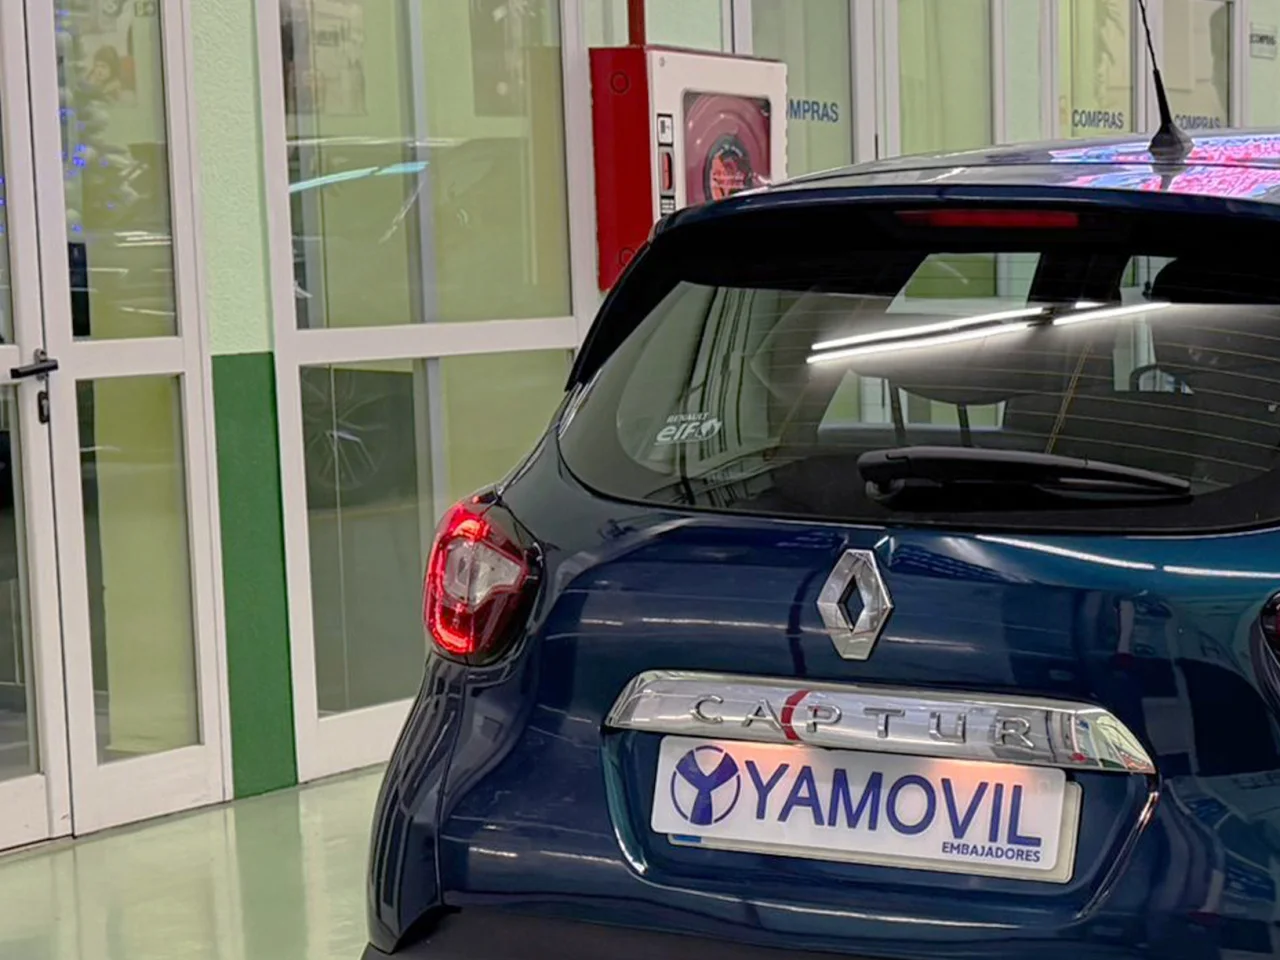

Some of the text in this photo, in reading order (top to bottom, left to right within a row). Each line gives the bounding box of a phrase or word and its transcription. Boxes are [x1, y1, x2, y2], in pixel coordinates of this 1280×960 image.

[787, 99, 839, 122] MPRAS
[1072, 110, 1124, 129] COMPRAS
[689, 694, 1035, 749] CAPTUR
[745, 759, 1042, 847] YAMOVIL
[941, 841, 1042, 863] EMBAJADORES
